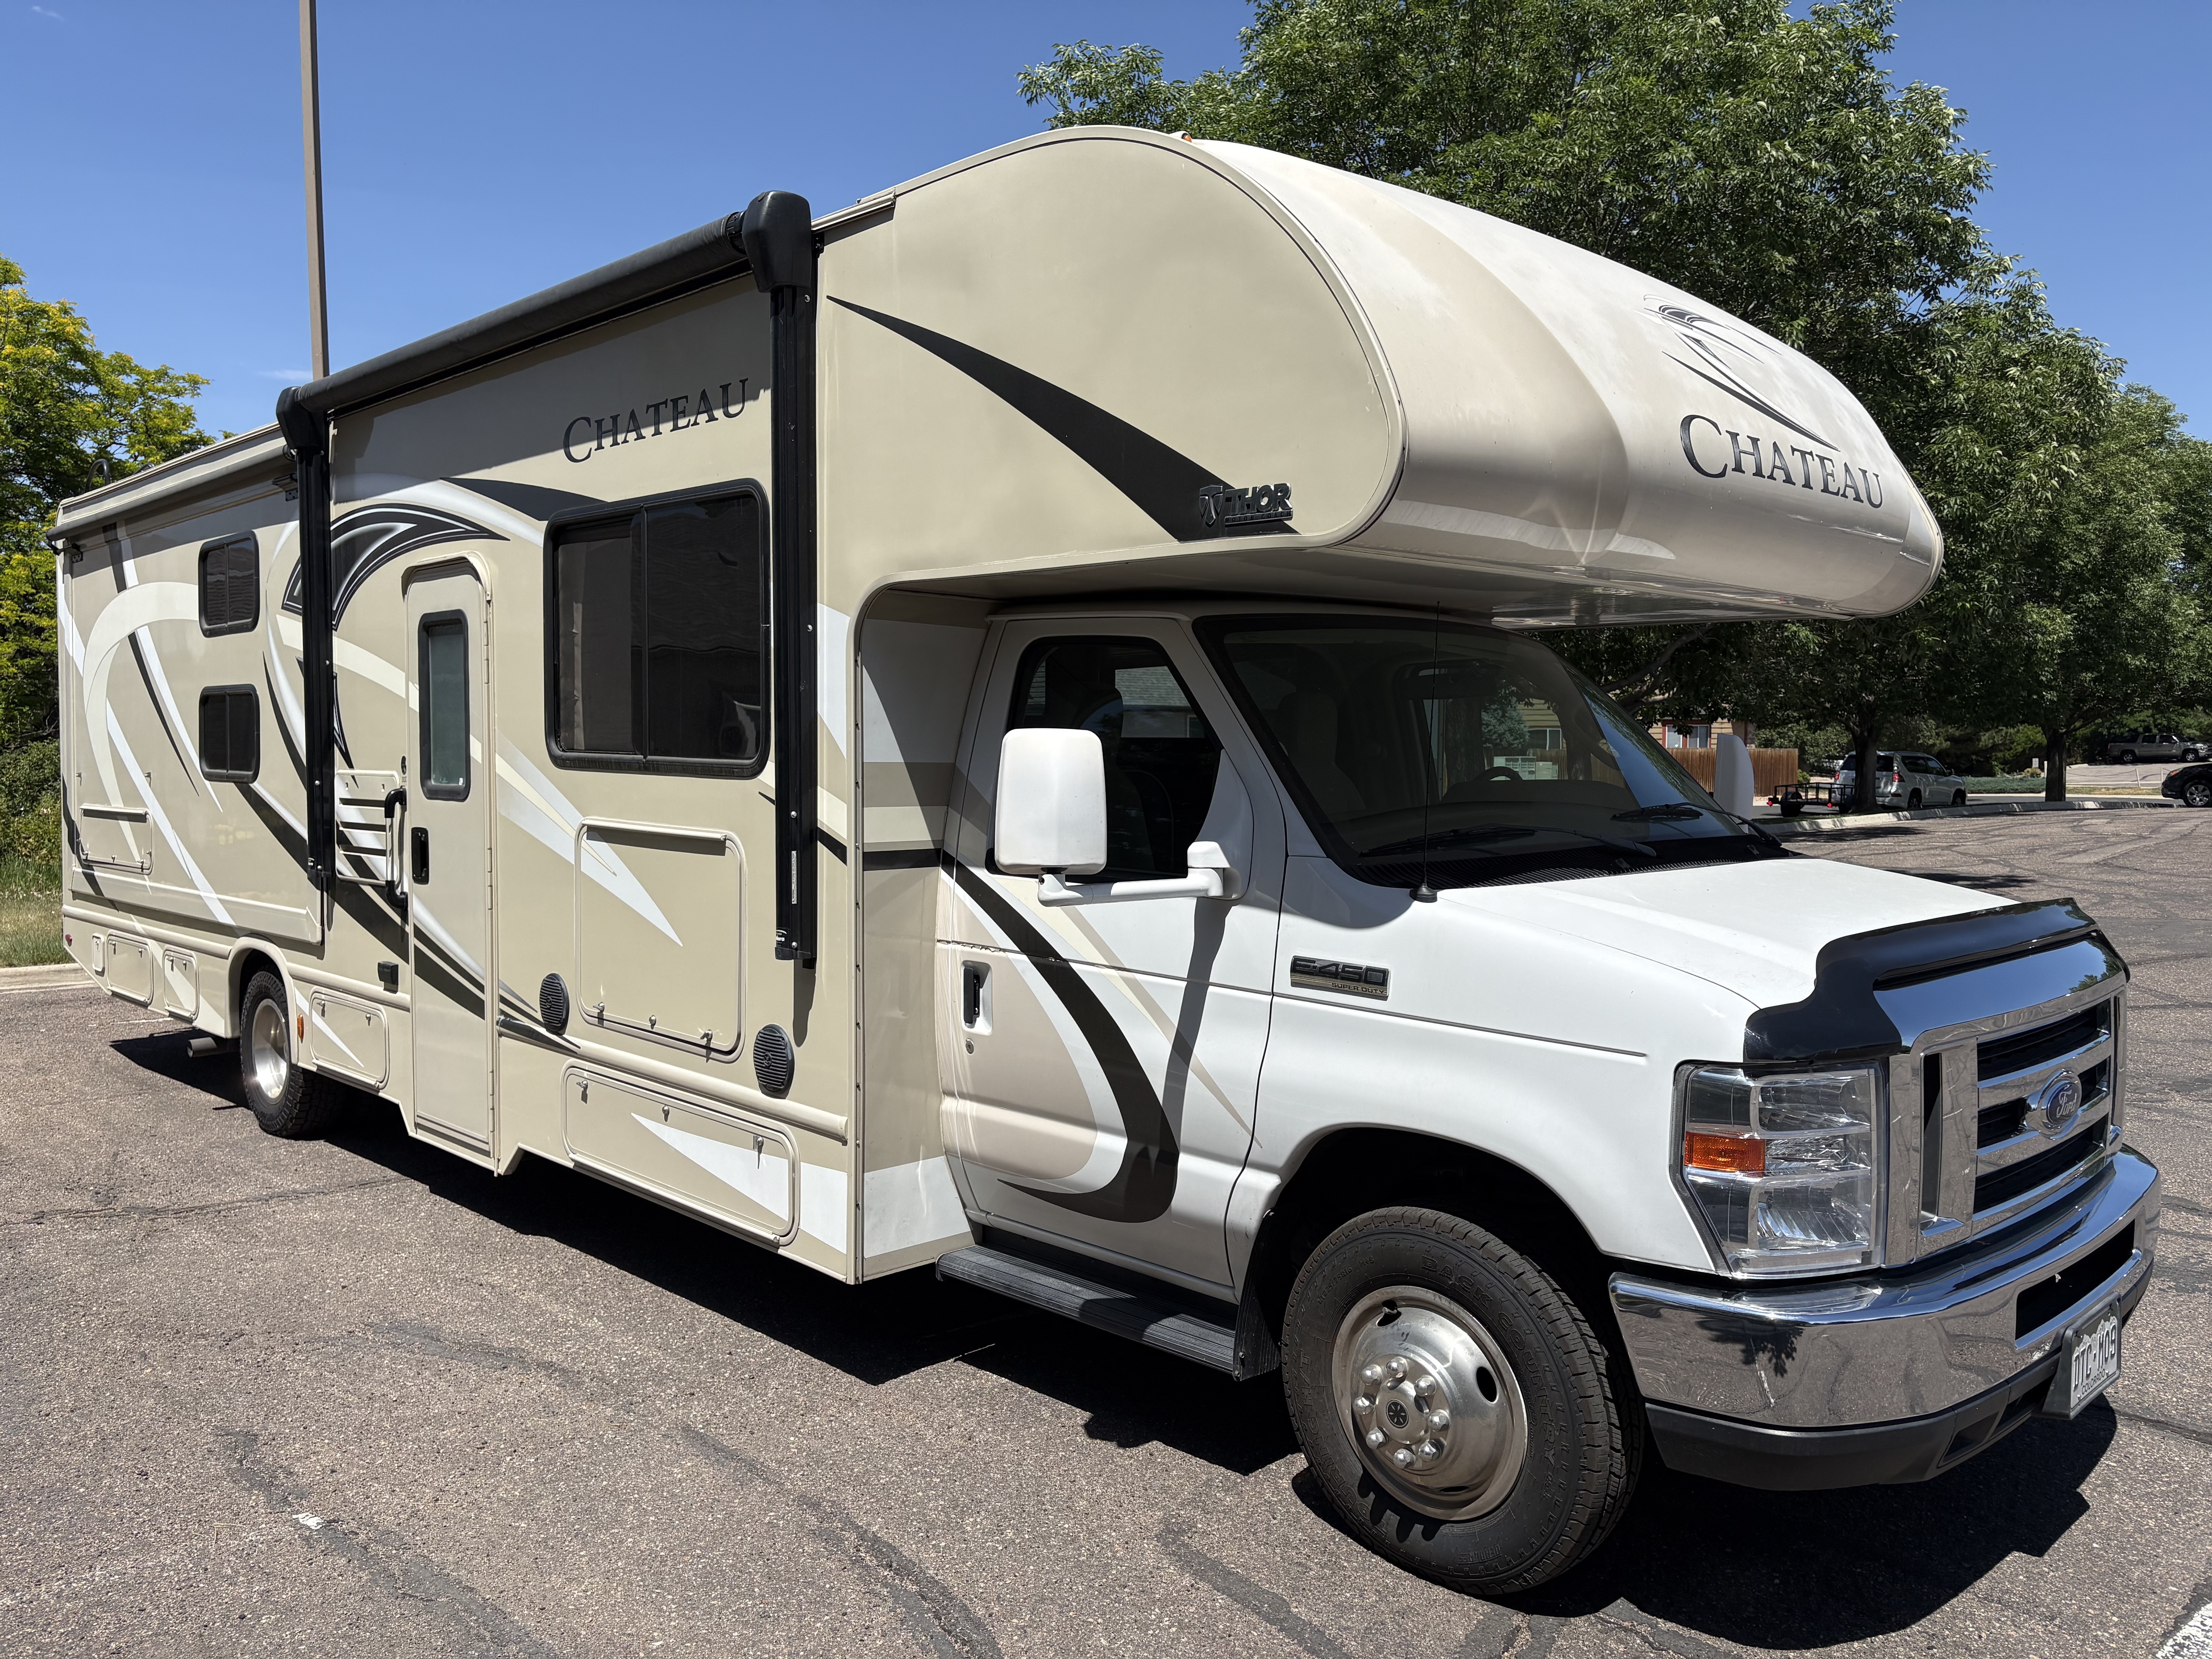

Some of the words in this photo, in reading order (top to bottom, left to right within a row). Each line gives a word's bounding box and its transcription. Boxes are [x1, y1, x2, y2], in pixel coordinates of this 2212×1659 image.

[562, 378, 749, 463] CHATEAU
[1680, 414, 1883, 508] CHATEAU
[1225, 483, 1293, 515] THOR
[1261, 510, 1292, 519] COACH
[1292, 957, 1388, 986] E-450
[1331, 982, 1360, 991] SUPER
[2056, 1089, 2077, 1118] Ford
[1422, 1255, 1493, 1309] BACK
[1498, 1311, 1556, 1467] COUNTRY
[2081, 1368, 2105, 1395] COLORADO
